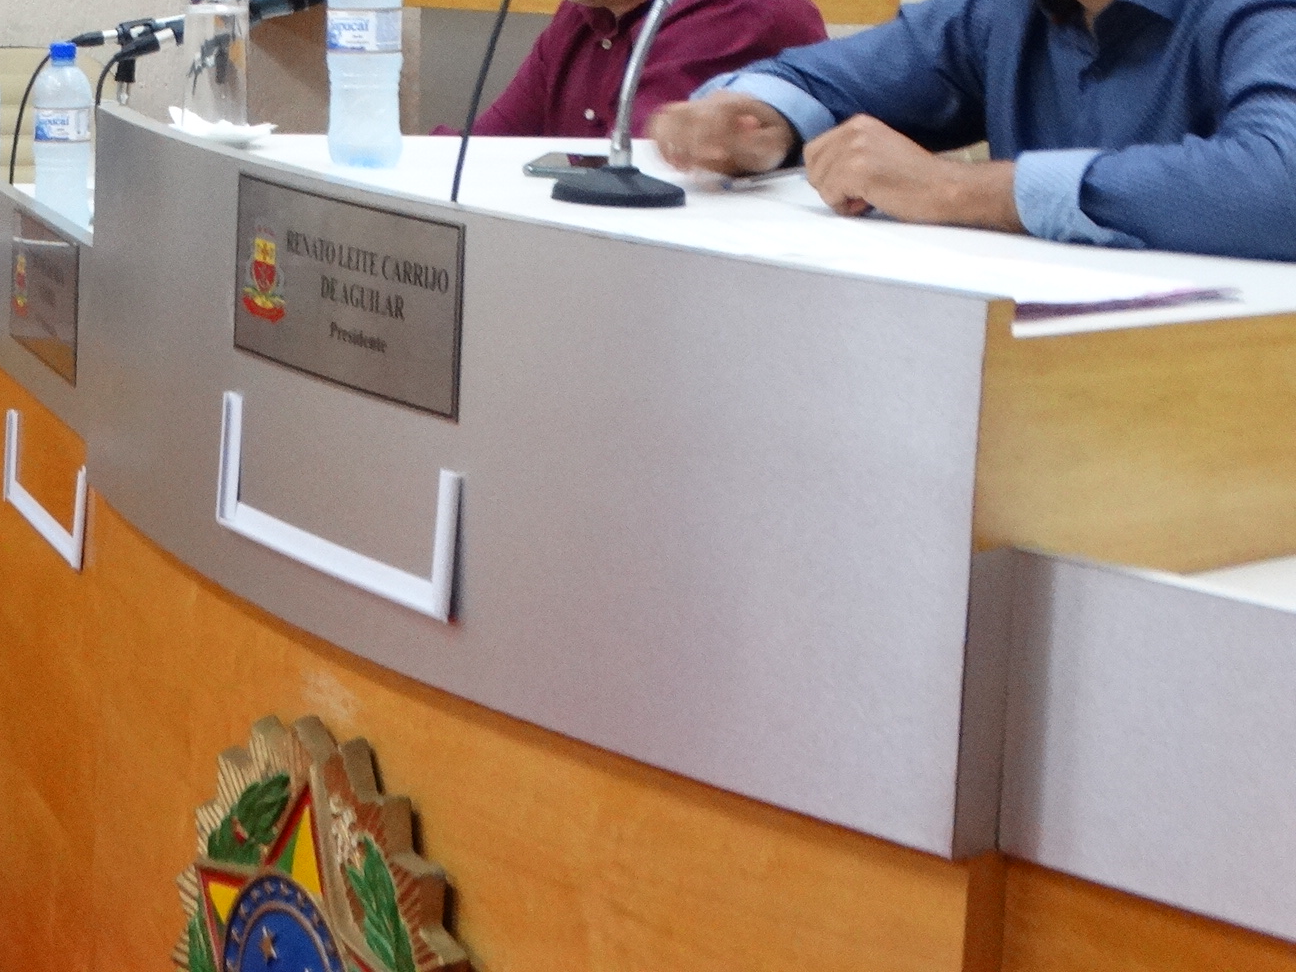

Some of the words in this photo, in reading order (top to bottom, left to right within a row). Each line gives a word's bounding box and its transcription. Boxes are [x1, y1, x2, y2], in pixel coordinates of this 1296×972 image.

[286, 230, 336, 265] RENATO
[338, 243, 378, 276] LEITE
[381, 253, 449, 294] CARRIJO
[320, 274, 338, 302] DE
[341, 281, 405, 321] AGUILAR
[329, 320, 388, 353] Presidente
